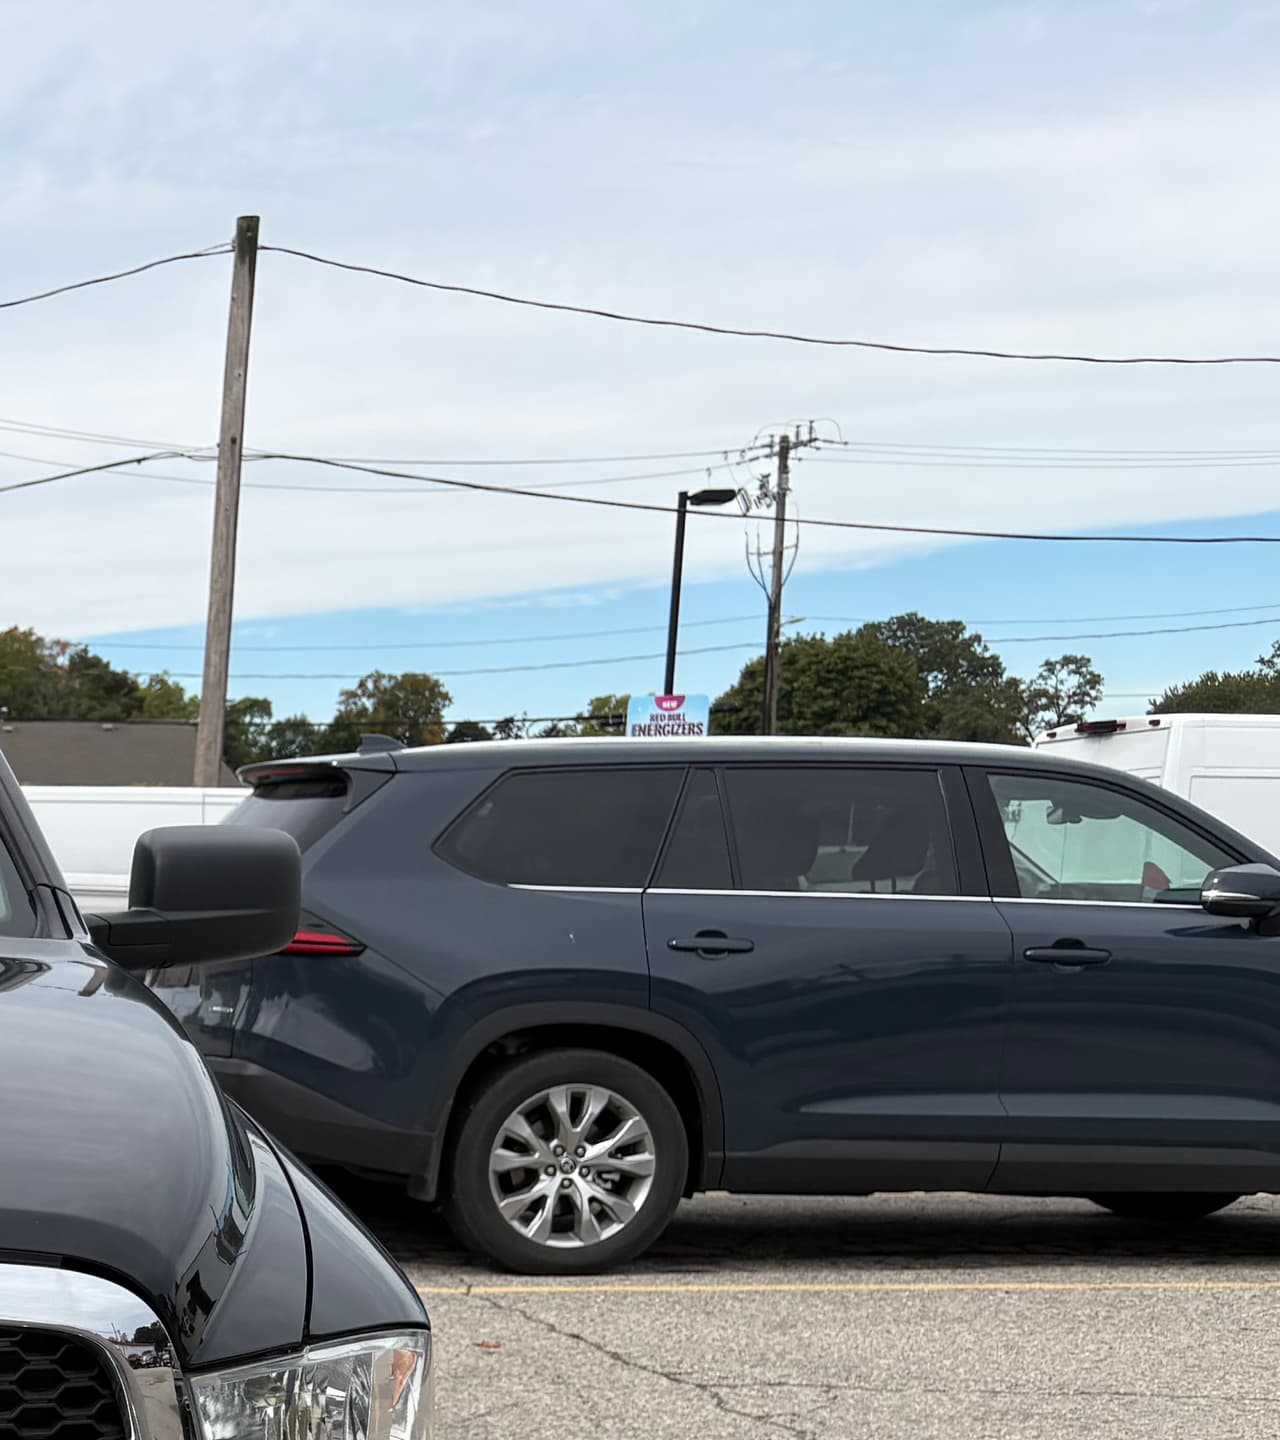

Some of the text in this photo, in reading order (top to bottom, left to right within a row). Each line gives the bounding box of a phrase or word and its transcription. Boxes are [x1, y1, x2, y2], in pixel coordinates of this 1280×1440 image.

[662, 701, 678, 709] NEW
[650, 713, 686, 722] RED BULL
[632, 722, 704, 737] ENERGIZERS
